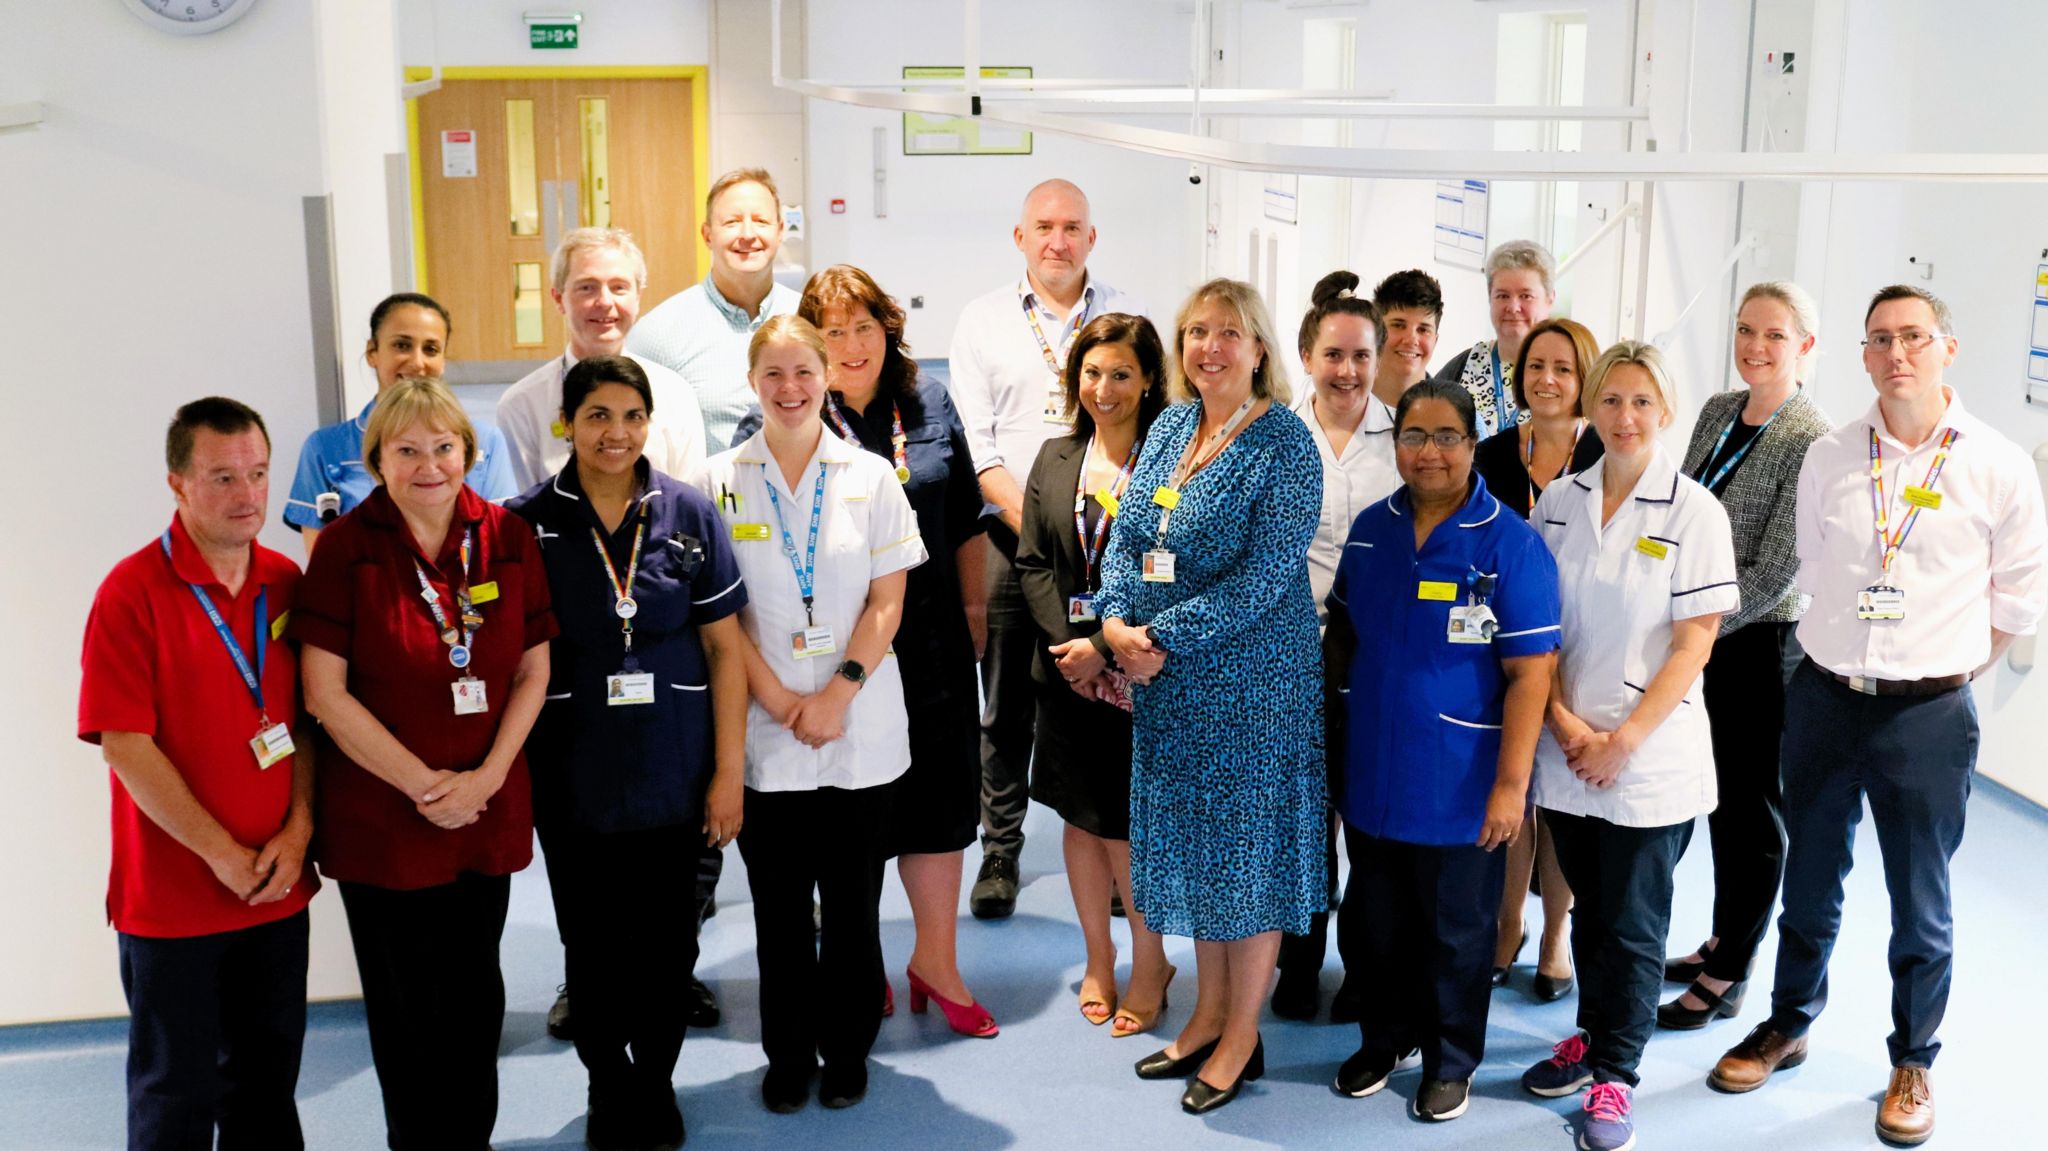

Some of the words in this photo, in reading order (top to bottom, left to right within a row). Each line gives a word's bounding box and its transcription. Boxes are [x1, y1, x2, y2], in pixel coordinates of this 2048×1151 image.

[185, 6, 195, 15] 6
[1871, 443, 1879, 458] NHS
[1927, 468, 1939, 484] NHS
[814, 494, 823, 508] NHS
[812, 513, 820, 528] NHS
[1095, 518, 1105, 534] NHS
[809, 532, 817, 547] NHS
[806, 552, 814, 567] NHS
[431, 603, 445, 622] NHS
